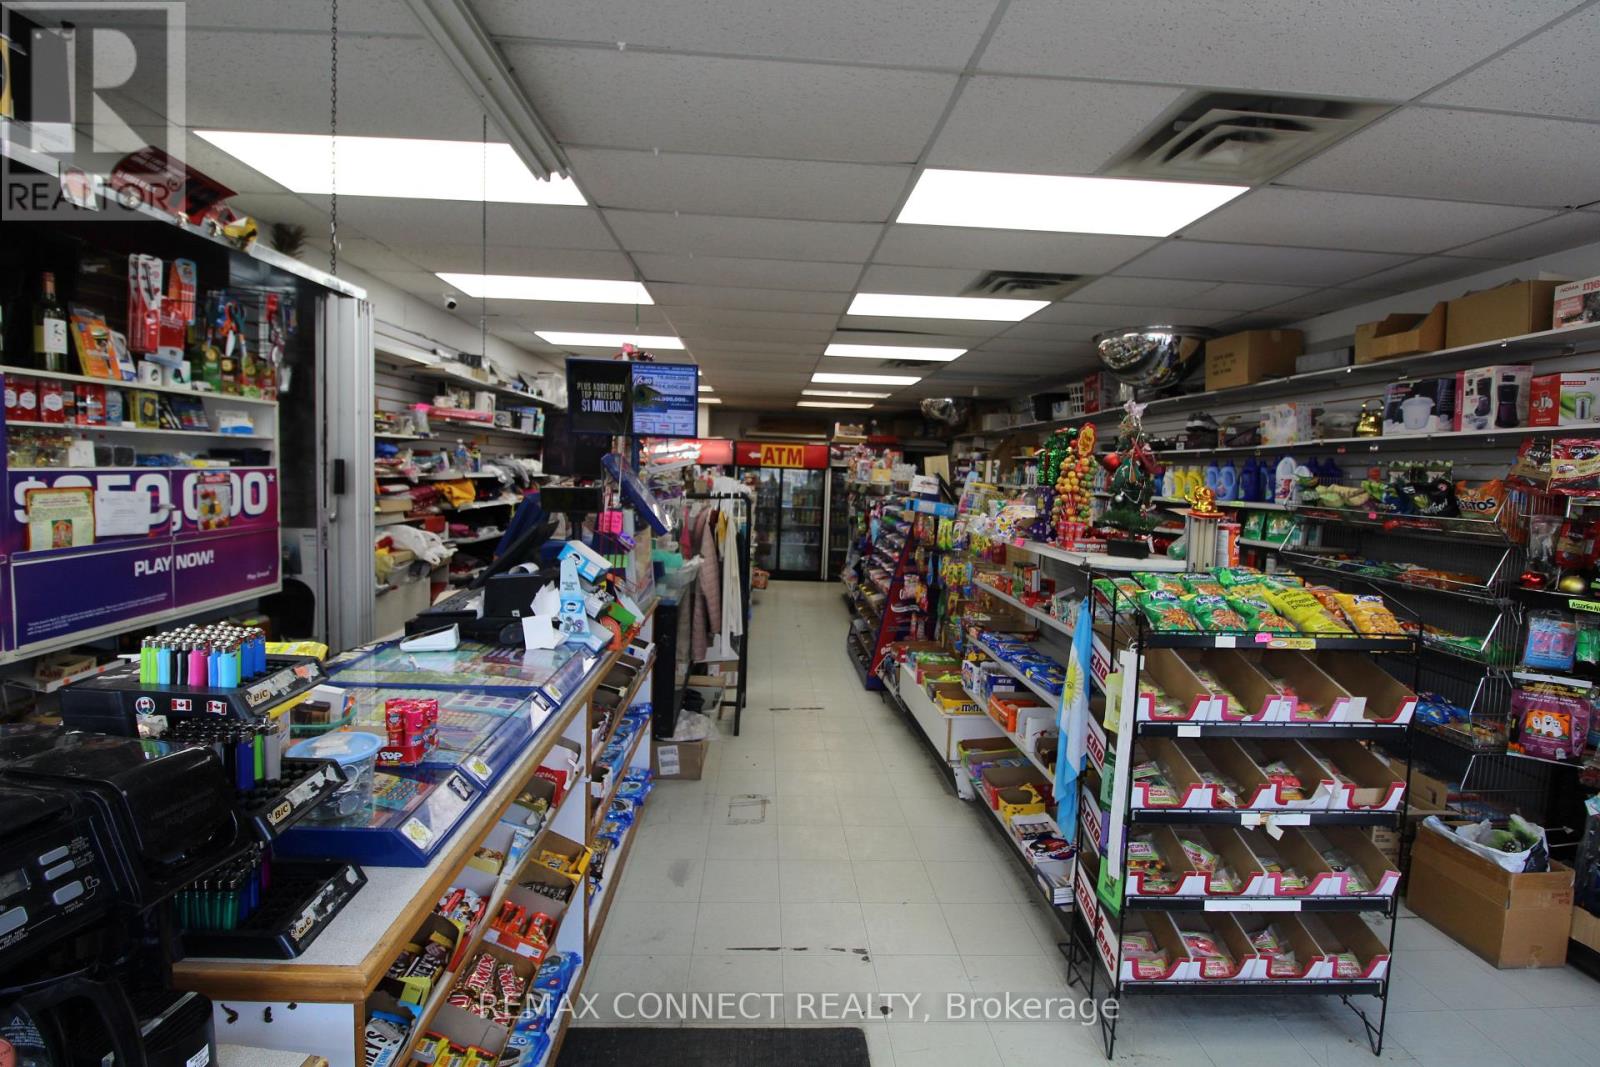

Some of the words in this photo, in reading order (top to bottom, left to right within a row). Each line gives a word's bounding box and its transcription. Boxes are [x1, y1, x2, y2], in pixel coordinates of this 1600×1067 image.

[592, 400, 623, 413] MILLION
[762, 447, 803, 466] ATM
[134, 556, 172, 577] PLAY
[176, 549, 215, 570] NOW!
[1075, 876, 1115, 972] Schotens
[465, 953, 496, 988] TWIX
